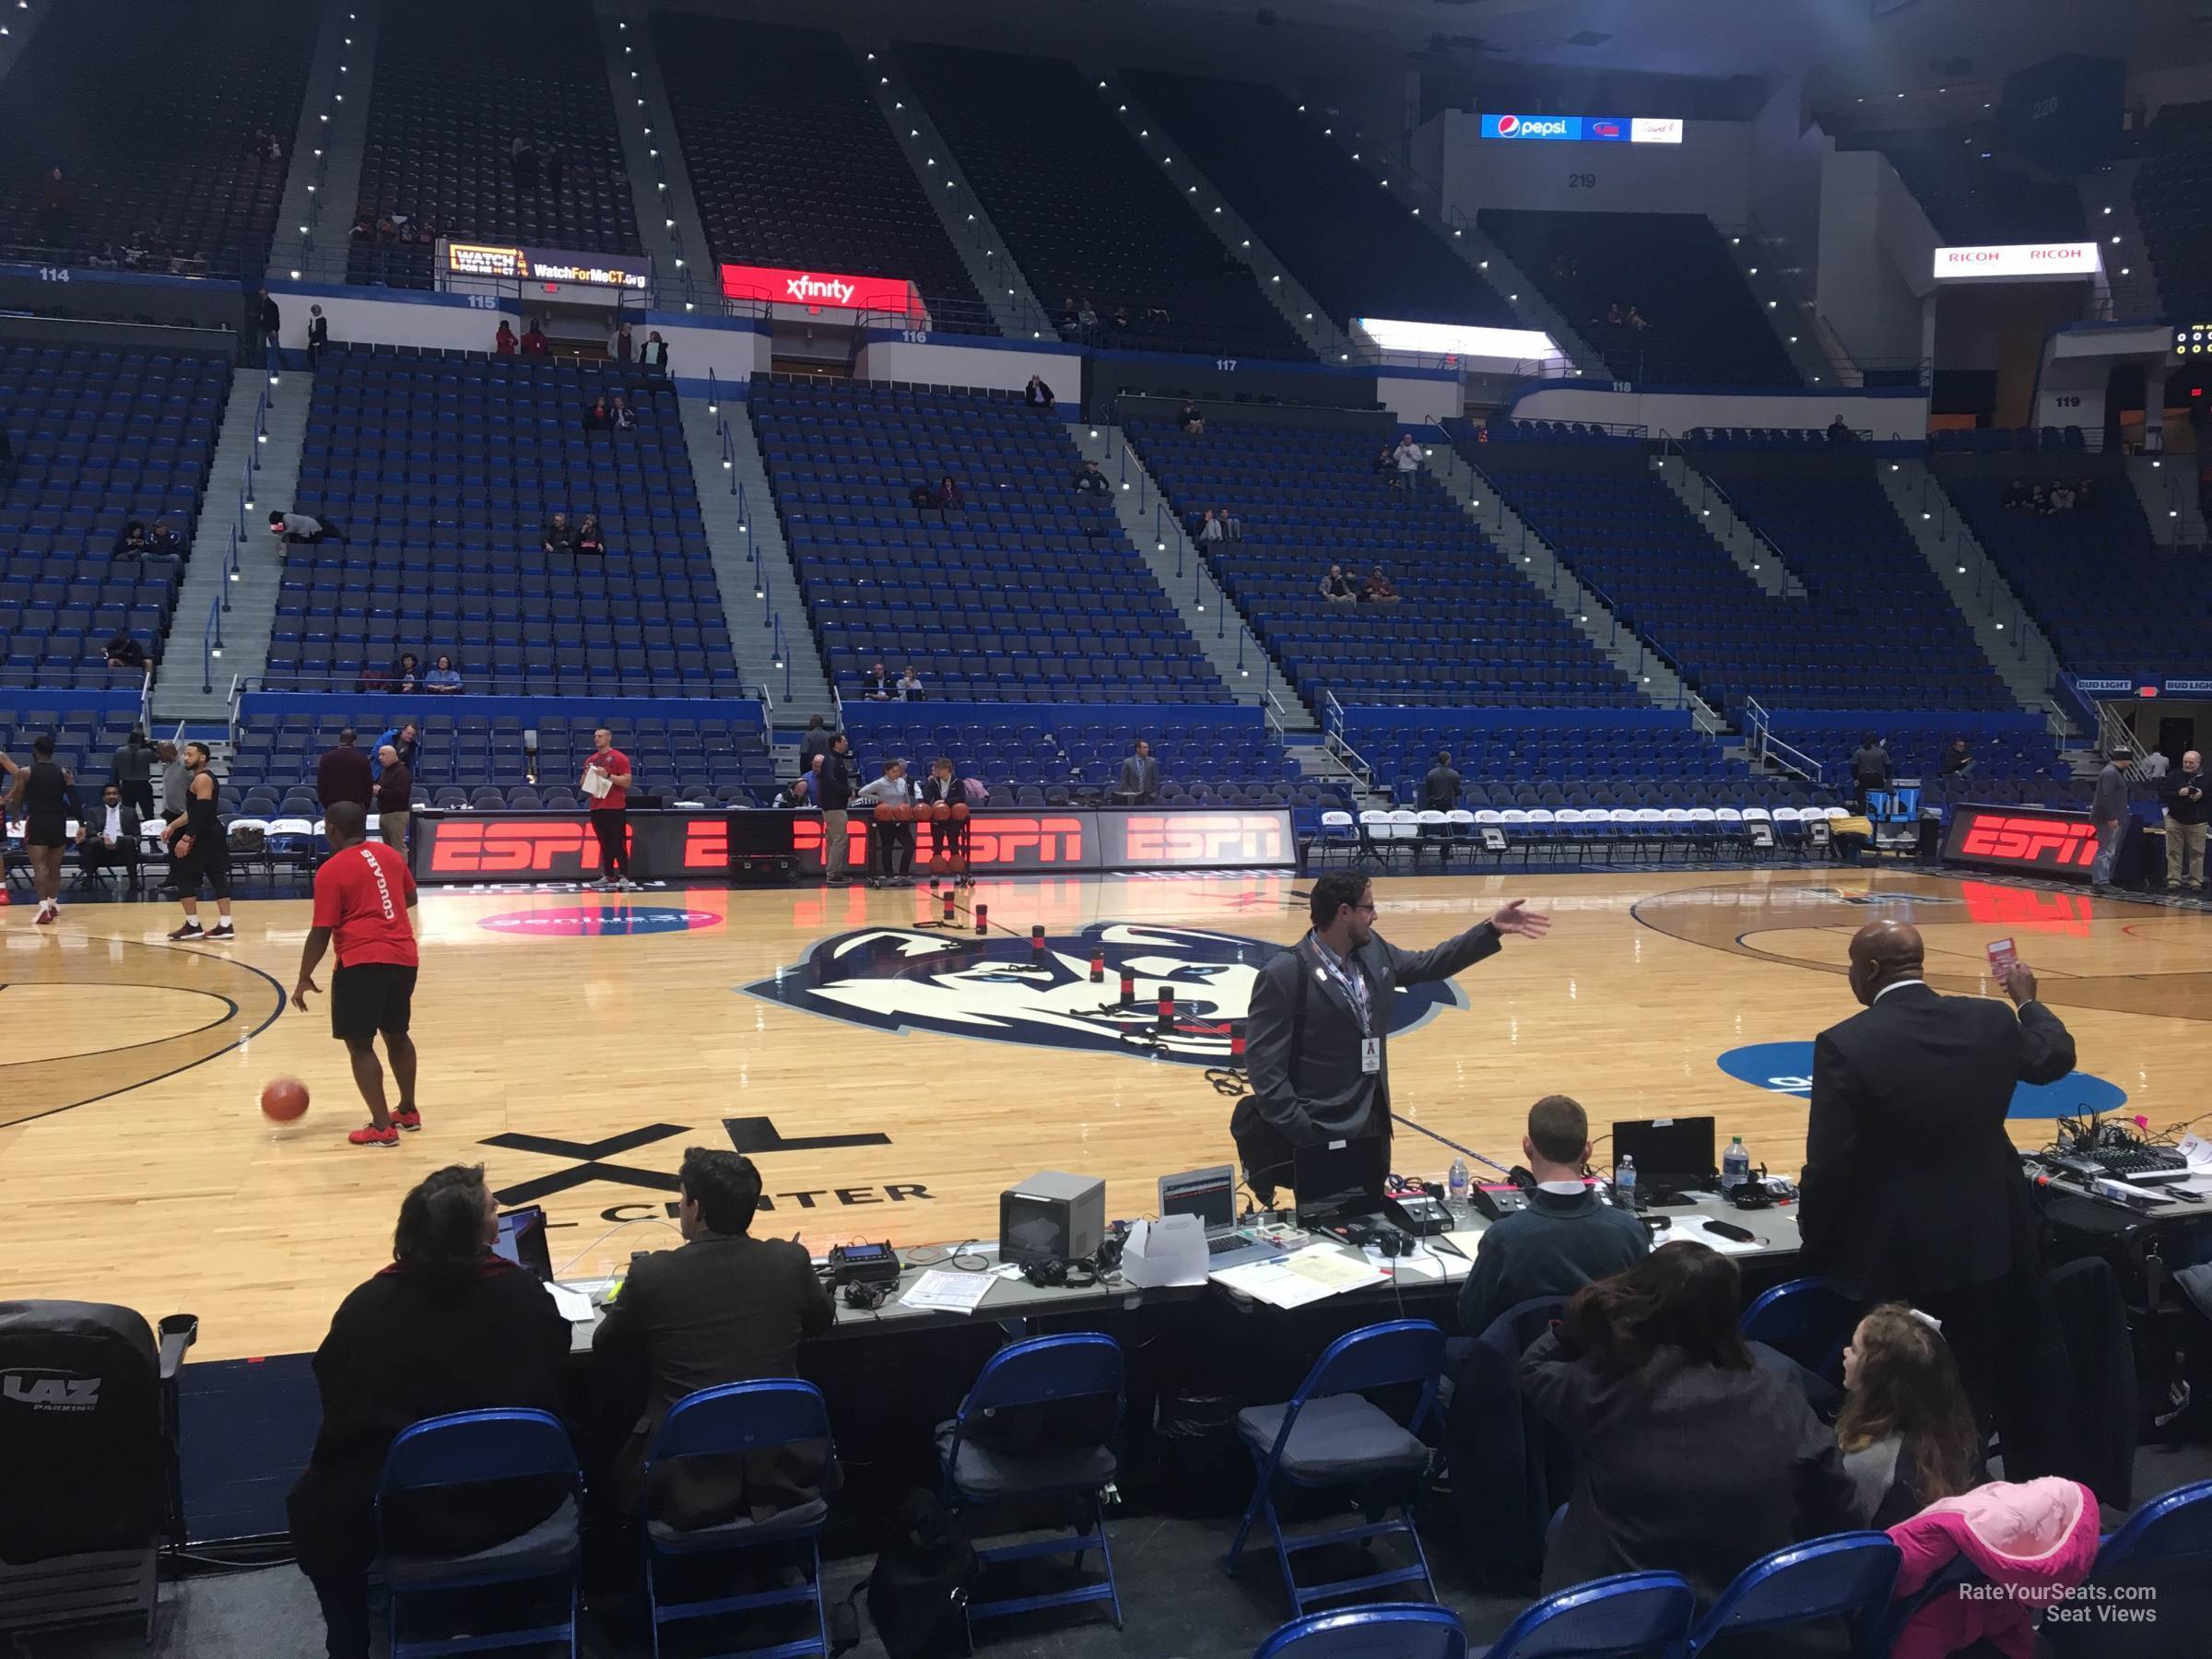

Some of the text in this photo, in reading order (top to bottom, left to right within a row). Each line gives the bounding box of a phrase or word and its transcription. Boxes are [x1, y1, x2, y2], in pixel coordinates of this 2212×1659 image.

[1522, 120, 1566, 136] pepsi
[1569, 173, 1596, 188] 219
[456, 251, 514, 266] WATCH
[1948, 249, 2082, 263] RICOH RICOH
[40, 267, 70, 282] 114
[502, 267, 514, 276] CT
[534, 264, 646, 288] WatchForMeCT.org
[786, 275, 854, 304] xfinity
[468, 295, 496, 309] 115
[902, 330, 927, 344] 116
[1217, 359, 1237, 371] 117
[1612, 382, 1631, 392] 118
[2055, 395, 2081, 408] 119
[2077, 681, 2130, 689] BUD LIGHT
[431, 822, 634, 871] ESPN
[1126, 817, 1282, 861] ESPN
[1961, 815, 2100, 866] ESPN
[359, 849, 395, 920] COUGARS
[475, 1116, 894, 1207] XL
[3, 1375, 102, 1405] LAZ
